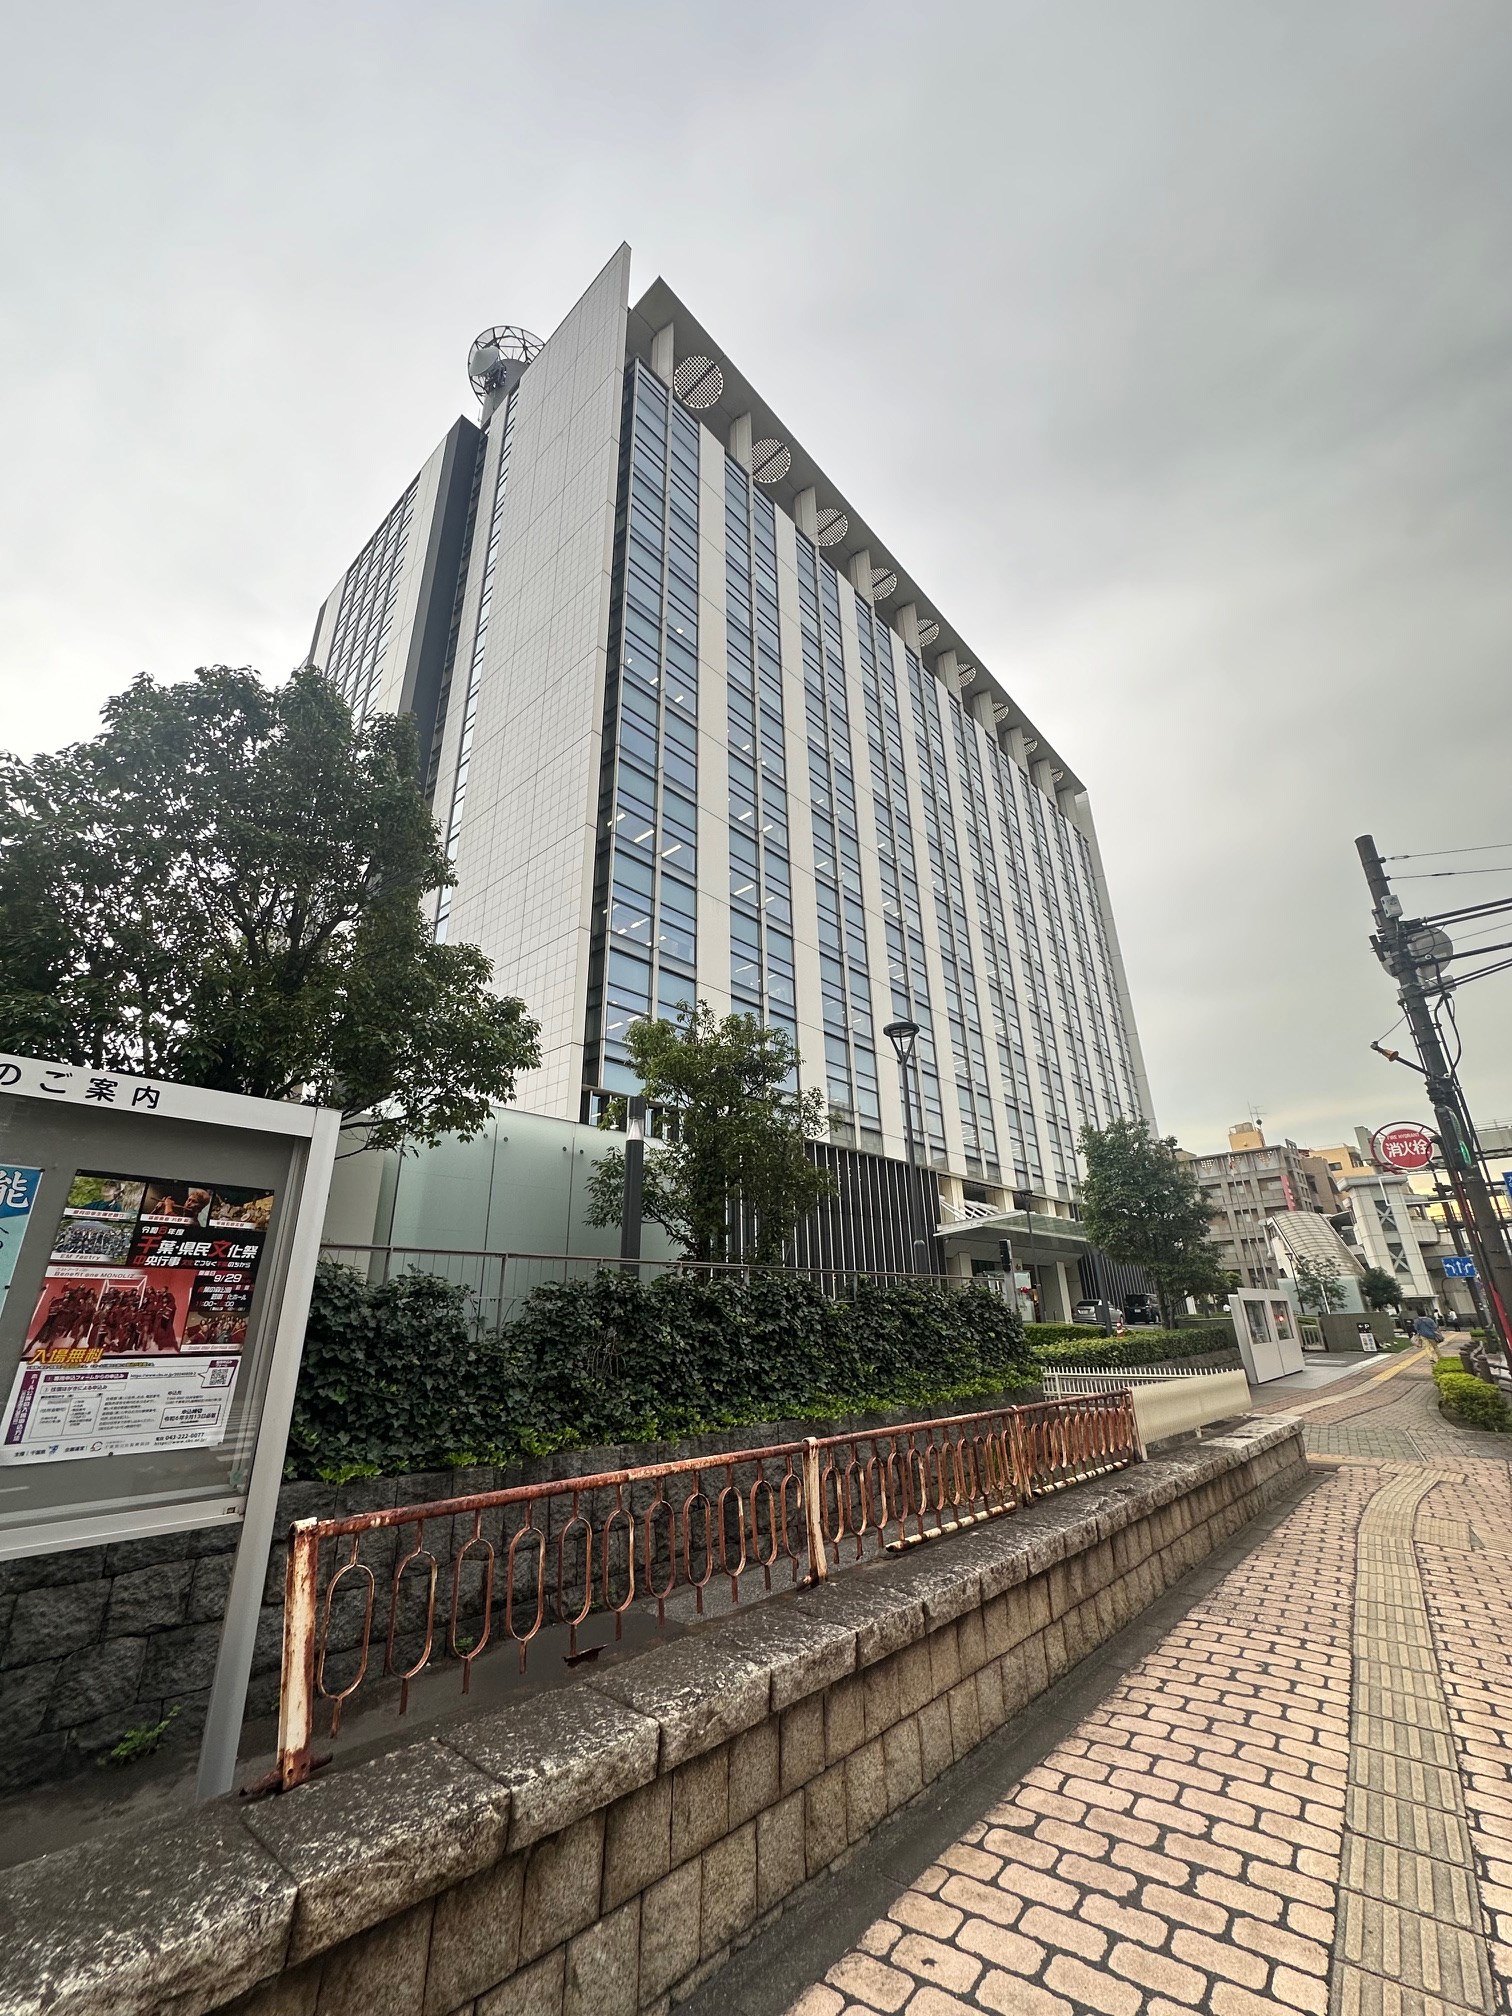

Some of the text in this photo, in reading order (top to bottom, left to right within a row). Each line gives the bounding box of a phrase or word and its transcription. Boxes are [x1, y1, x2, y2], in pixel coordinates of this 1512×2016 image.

[0, 1063, 161, 1109] のご案内
[1385, 1139, 1430, 1158] 消火栓
[213, 1273, 243, 1284] 9/29
[28, 1348, 104, 1364] 入場無料
